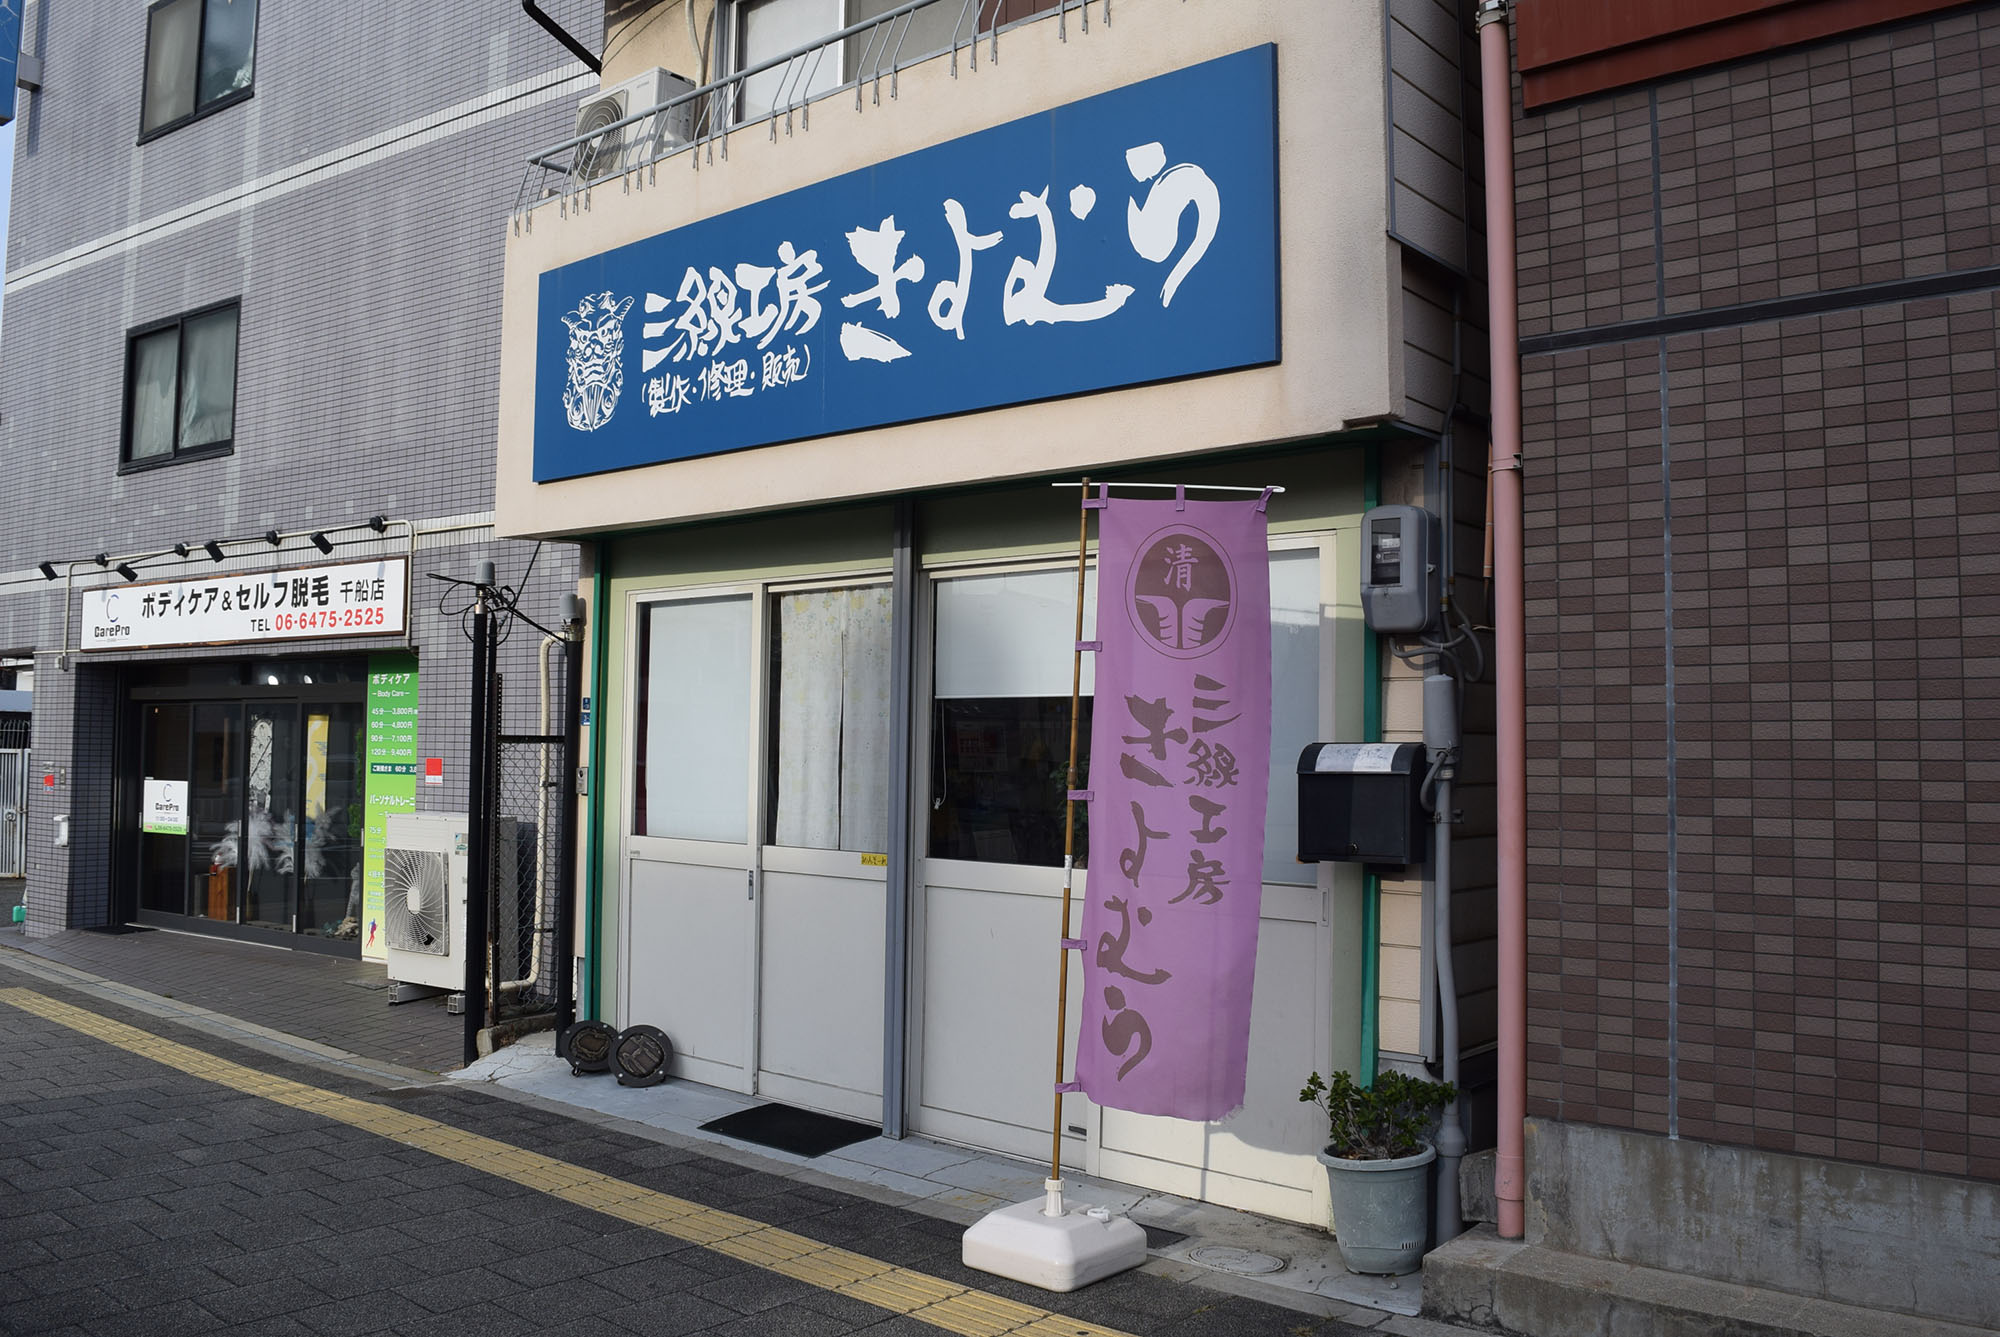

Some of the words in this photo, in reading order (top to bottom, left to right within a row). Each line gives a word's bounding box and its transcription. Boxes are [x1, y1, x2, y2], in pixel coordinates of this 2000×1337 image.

[840, 142, 1220, 362] きよむら
[1163, 543, 1199, 592] 清
[340, 578, 385, 604] 千船店
[94, 625, 130, 638] CarePro
[251, 619, 270, 632] TEL
[372, 673, 410, 685] ボディケア
[1168, 673, 1243, 905] 三線工房
[1096, 694, 1189, 1081] きよむら
